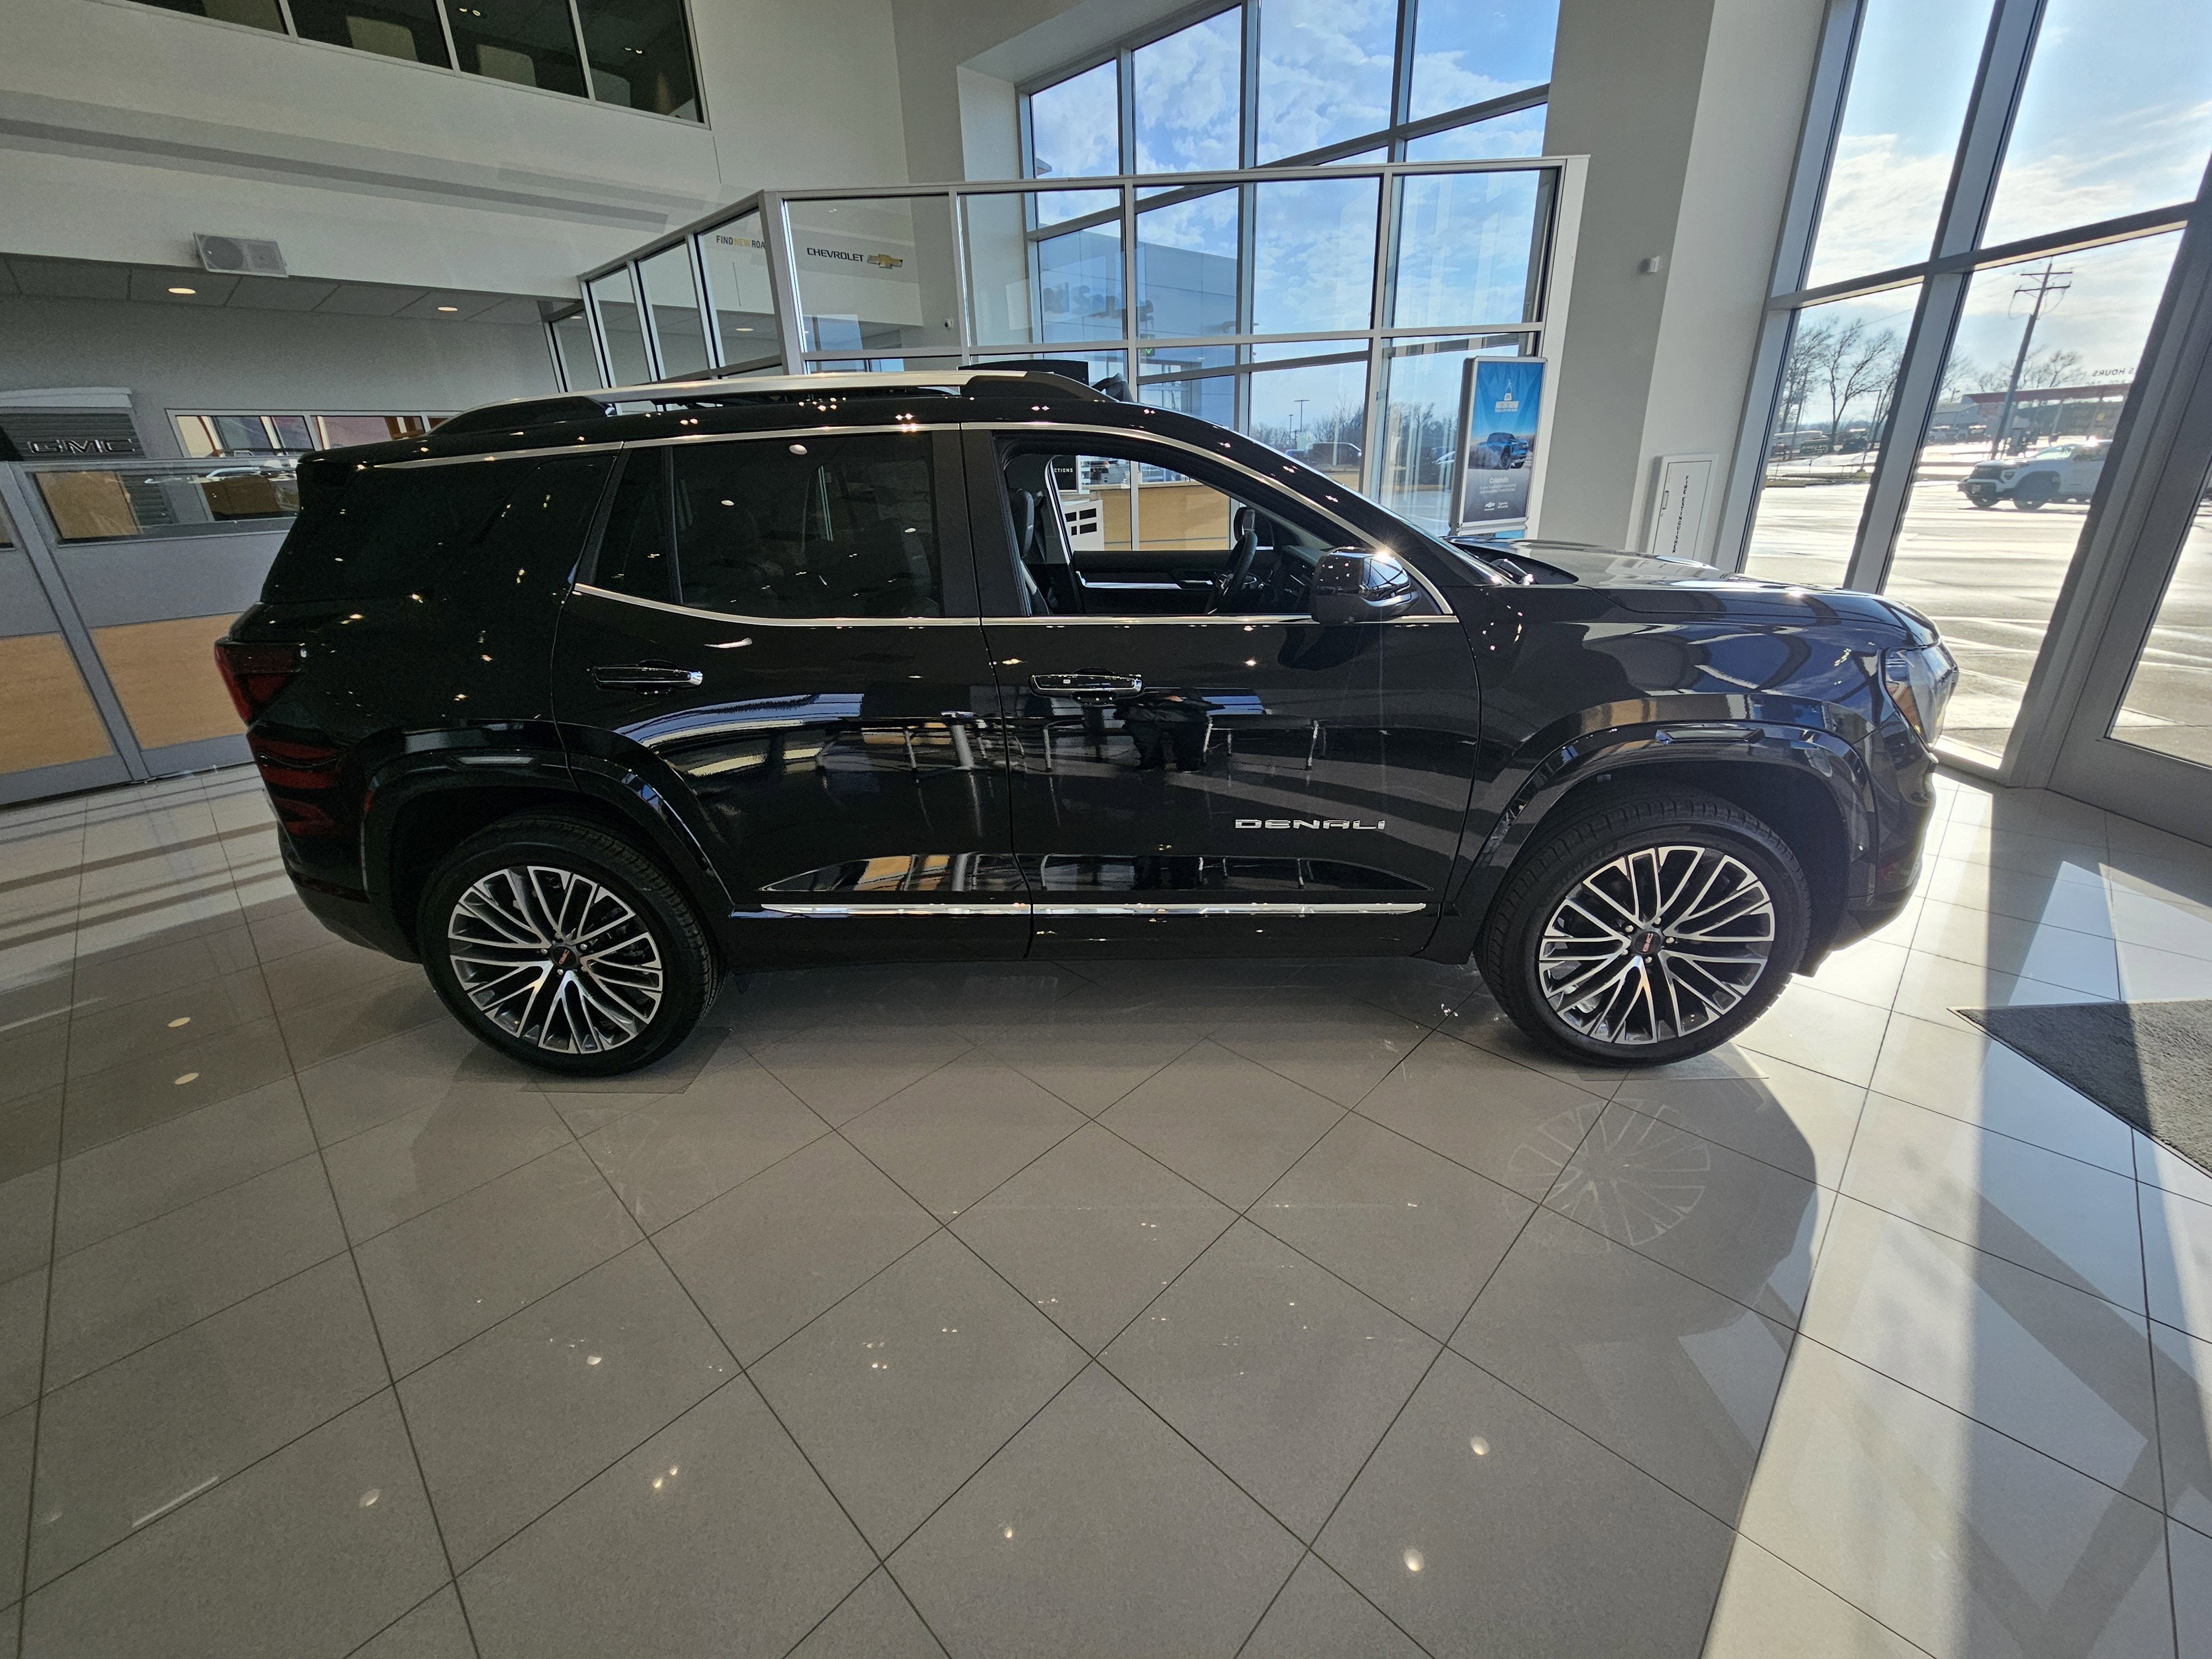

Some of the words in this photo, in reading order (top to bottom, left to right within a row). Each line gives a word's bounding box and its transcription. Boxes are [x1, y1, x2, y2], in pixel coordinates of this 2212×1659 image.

[716, 235, 733, 245] FIND
[734, 237, 751, 247] NEW
[806, 247, 864, 262] CHEVROLET
[27, 439, 135, 454] GMC
[1672, 497, 1686, 553] EXTINGUISHER
[1235, 819, 1385, 830] DENALI
